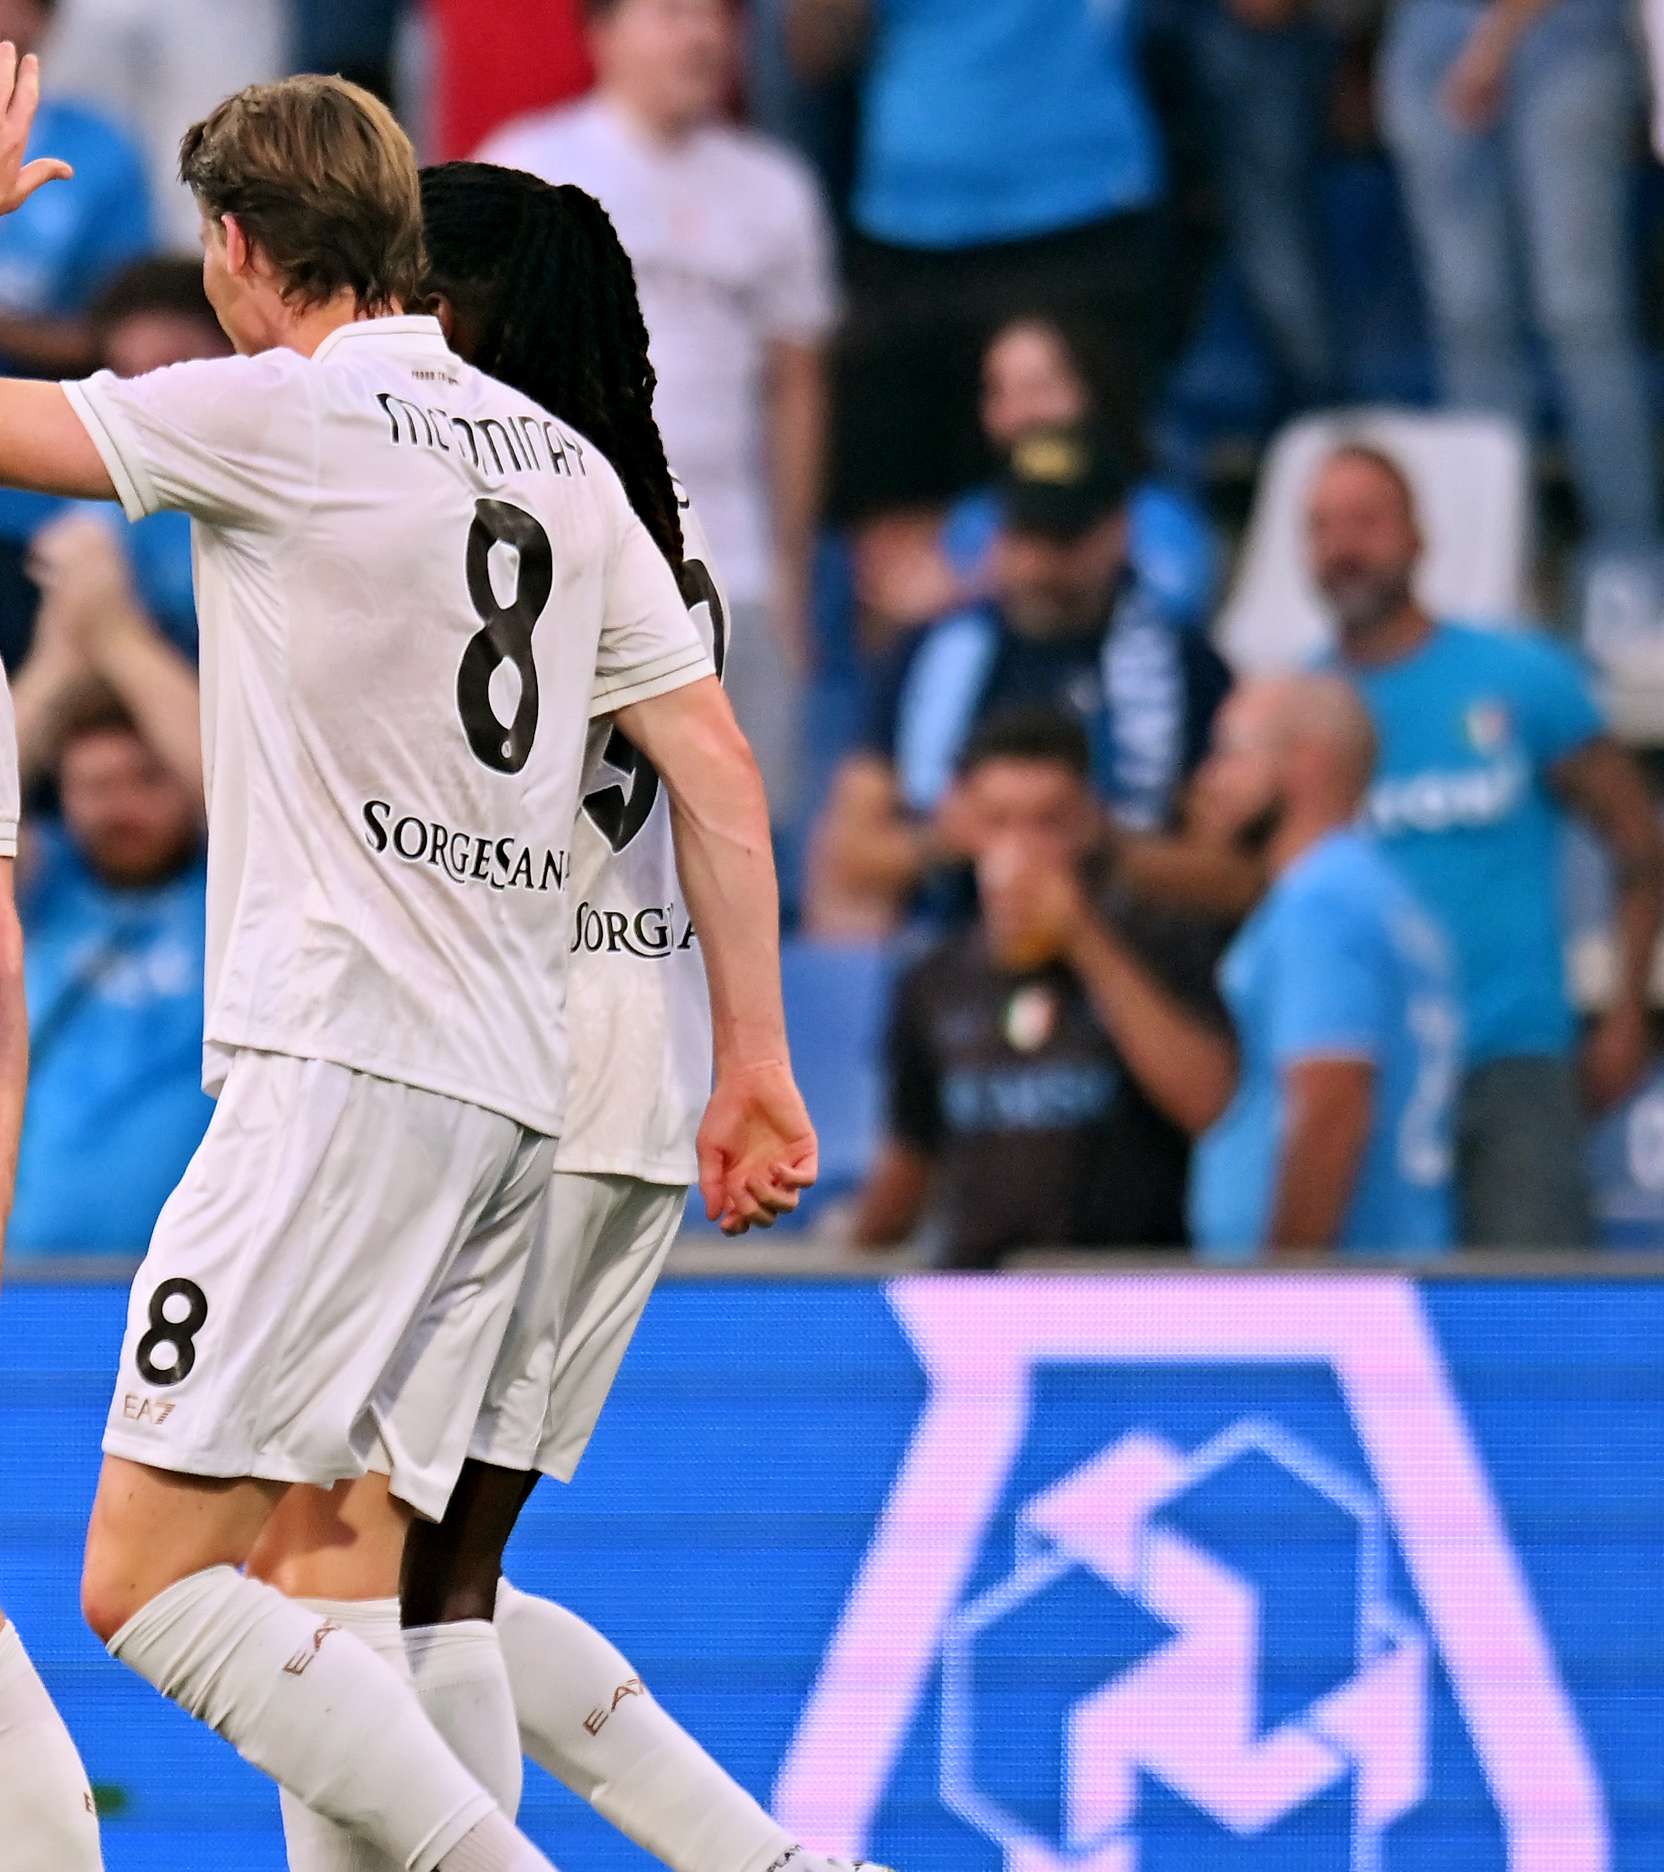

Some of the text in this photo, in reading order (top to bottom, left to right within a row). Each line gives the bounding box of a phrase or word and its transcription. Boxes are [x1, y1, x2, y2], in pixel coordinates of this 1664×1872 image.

[456, 498, 553, 776] 8
[363, 800, 570, 891] SORGESAN
[137, 1277, 208, 1387] 8
[123, 1394, 176, 1425] EA7
